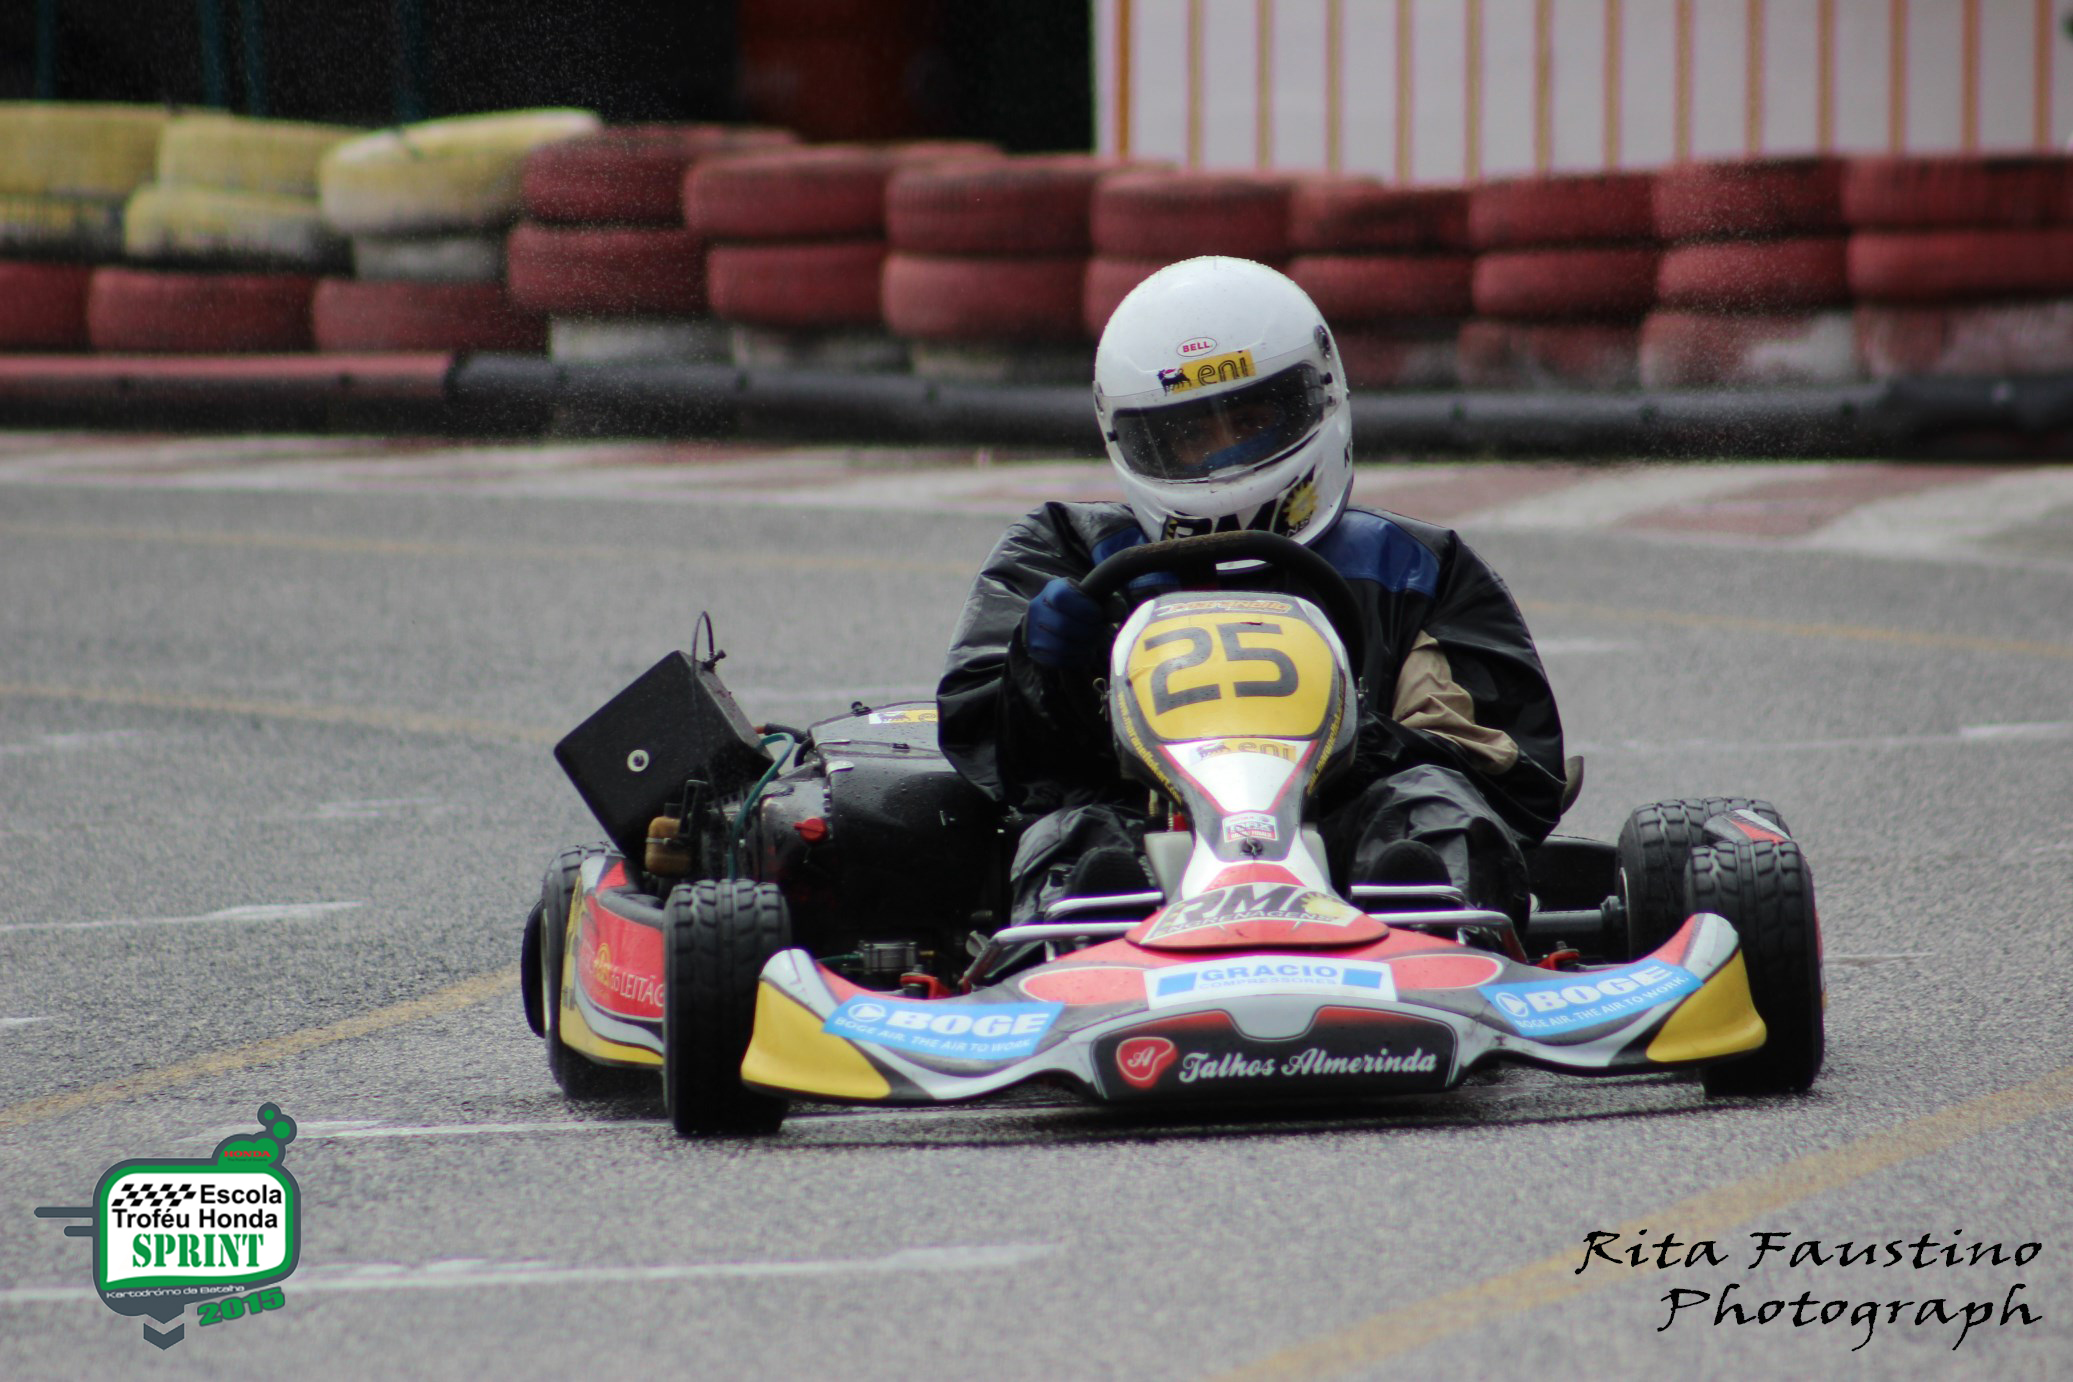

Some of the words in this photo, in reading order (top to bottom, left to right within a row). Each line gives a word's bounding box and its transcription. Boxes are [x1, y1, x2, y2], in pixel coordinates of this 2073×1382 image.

[1182, 341, 1211, 353] BELL
[1197, 350, 1249, 387] eni
[1143, 621, 1299, 716] 25
[1199, 976, 1338, 990] COMPRESSORES
[1200, 964, 1339, 981] GRACIO
[1524, 965, 1673, 1013] BOGE
[1573, 1007, 1602, 1021] THE
[1600, 1000, 1626, 1016] AIR
[1626, 994, 1645, 1007] TO
[1642, 976, 1690, 1002] WORK.
[834, 1016, 876, 1035] BOGE
[911, 1035, 938, 1049] THE
[939, 1039, 968, 1051] AIR
[970, 1042, 989, 1053] TO
[886, 1010, 1050, 1038] BOGE
[1178, 1051, 1276, 1083] Talhos
[1280, 1046, 1437, 1077] Almerinda
